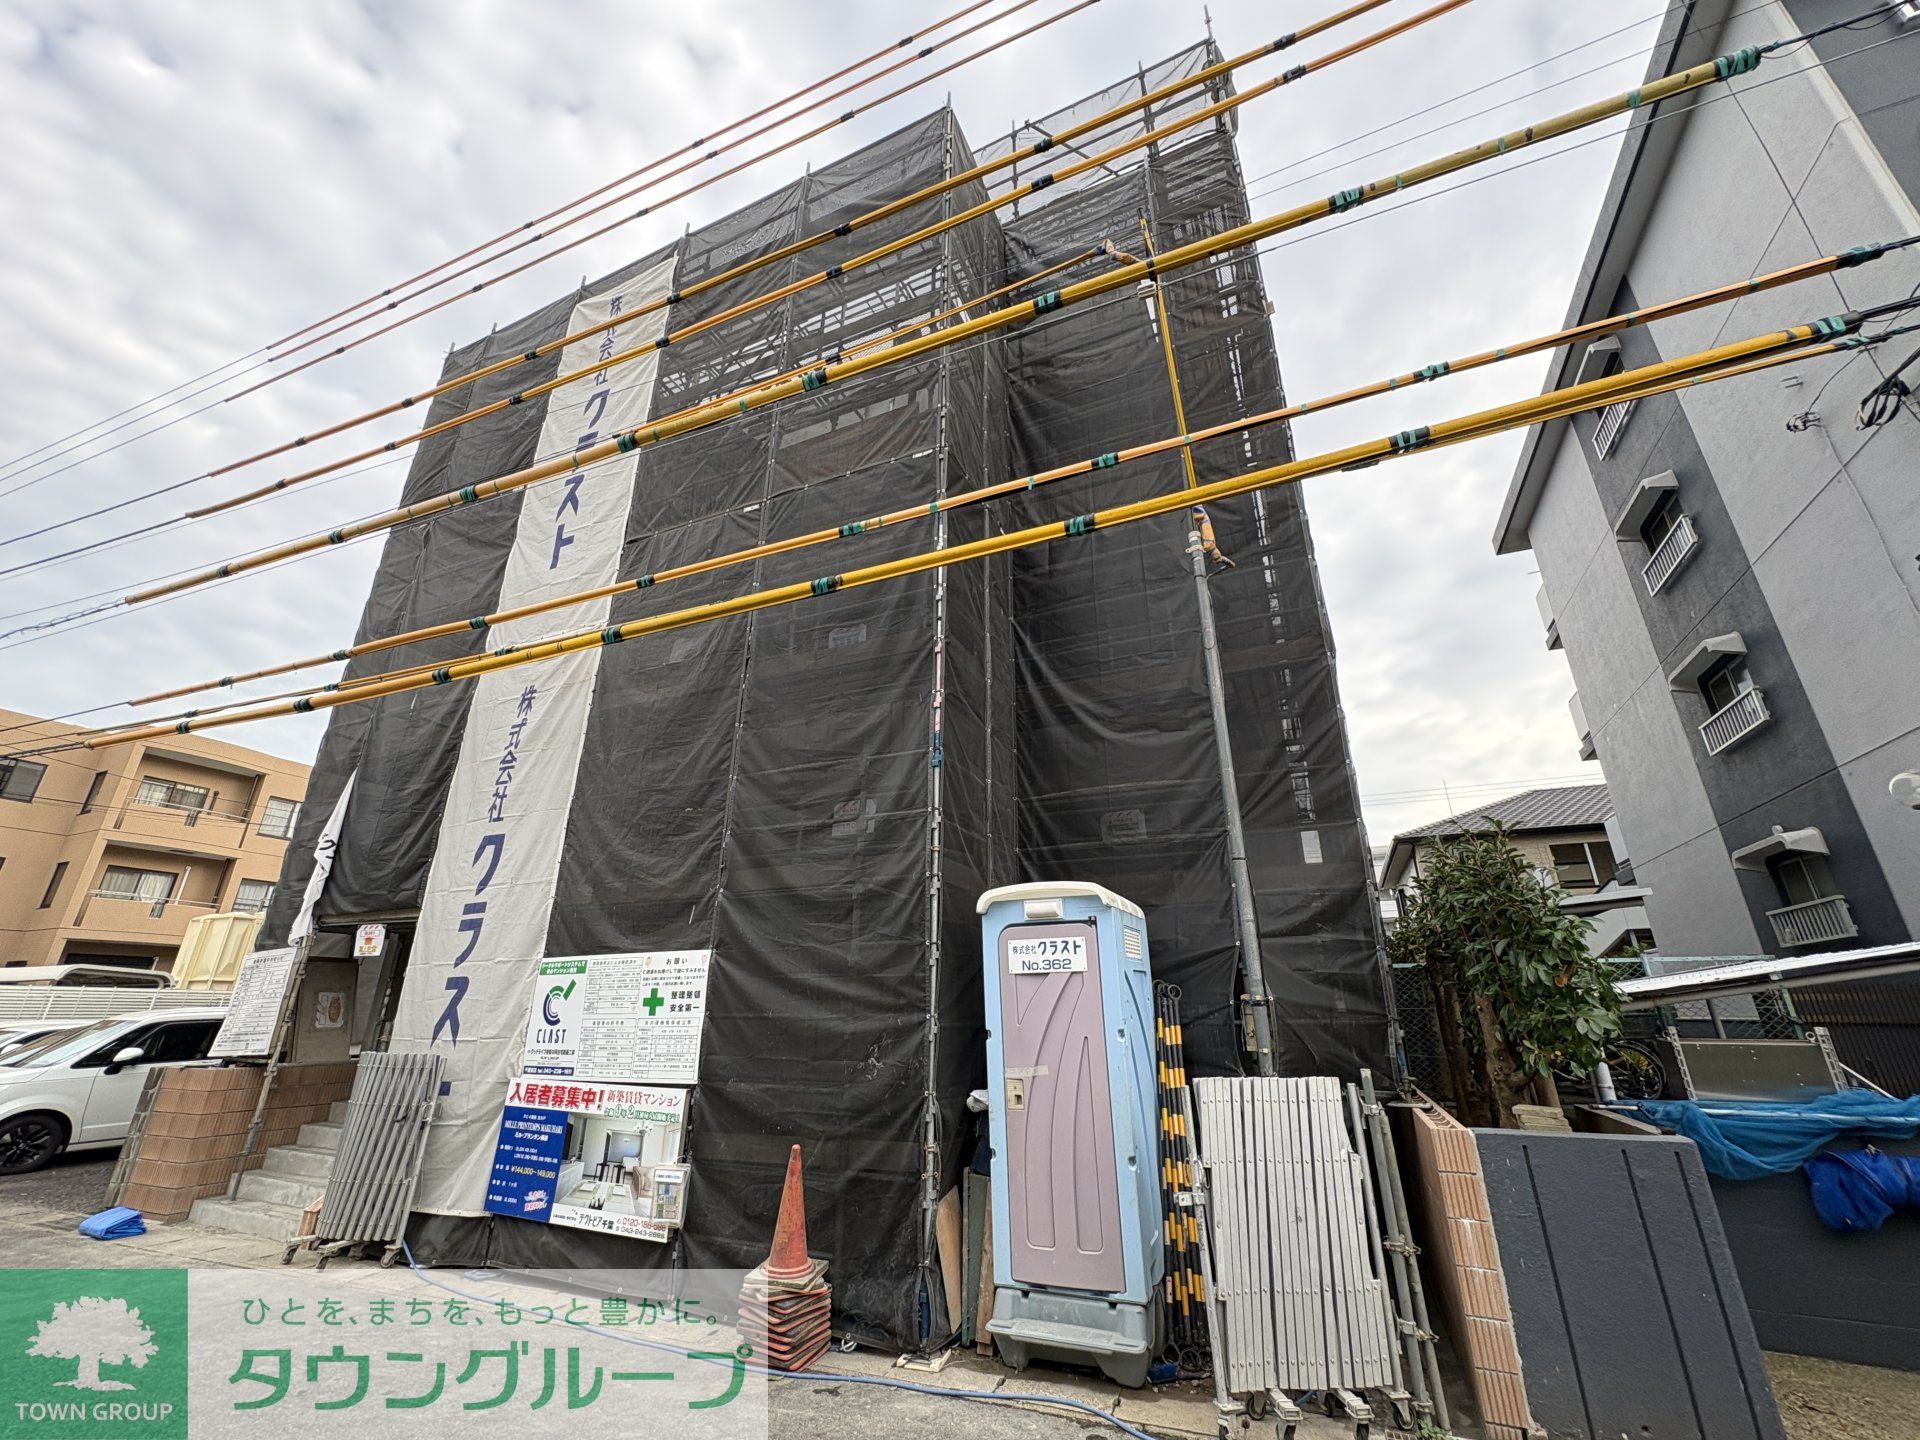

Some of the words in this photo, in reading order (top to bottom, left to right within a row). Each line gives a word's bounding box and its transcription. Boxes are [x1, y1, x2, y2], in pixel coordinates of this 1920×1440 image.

[1012, 940, 1082, 956] 株式会社クラスト
[1021, 958, 1072, 971] No.362
[671, 990, 701, 999] 整理整頓
[669, 1003, 700, 1013] 安全第一
[536, 1028, 567, 1044] CLAST
[509, 1082, 604, 1111] 入居者募集中!
[607, 1089, 682, 1107] 新築賃貸マンション
